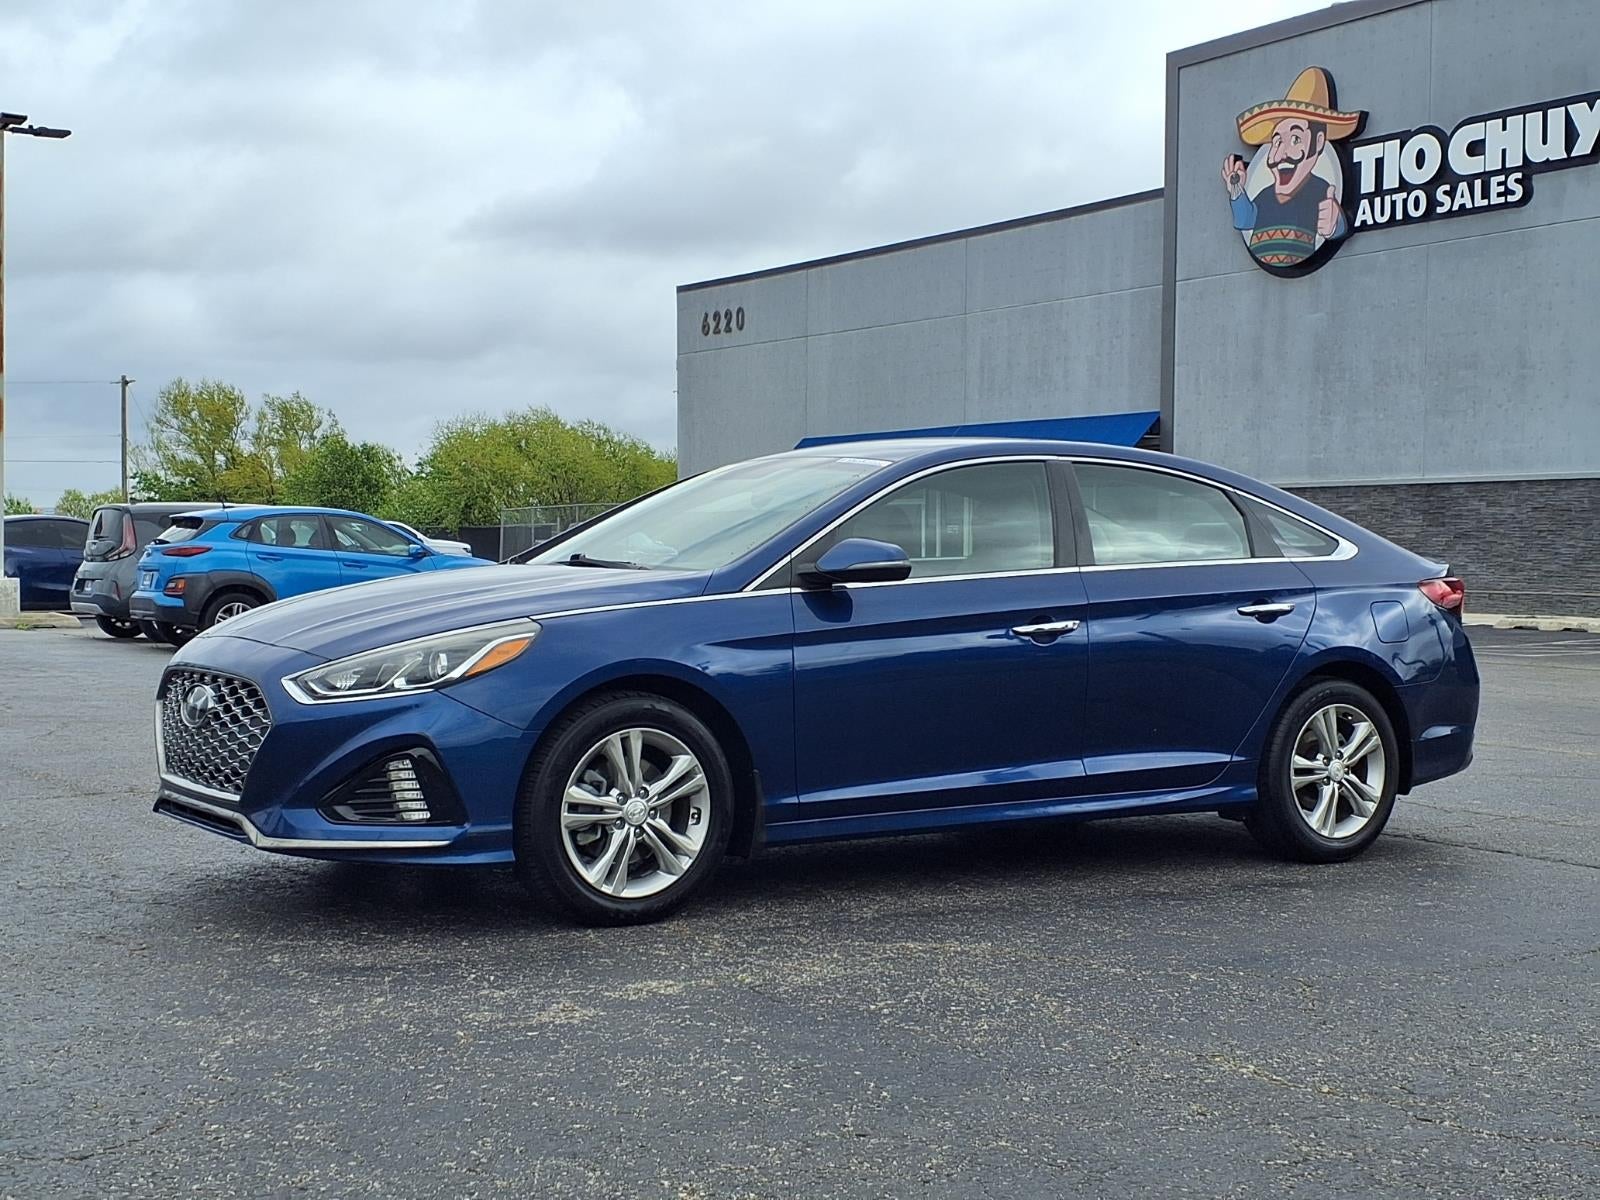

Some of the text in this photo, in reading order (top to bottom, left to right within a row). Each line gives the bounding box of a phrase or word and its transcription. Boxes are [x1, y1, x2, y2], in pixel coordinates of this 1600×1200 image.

[1353, 98, 1600, 194] TIO CHUY
[1354, 172, 1523, 227] AUTO SALES
[701, 306, 745, 336] 6220
